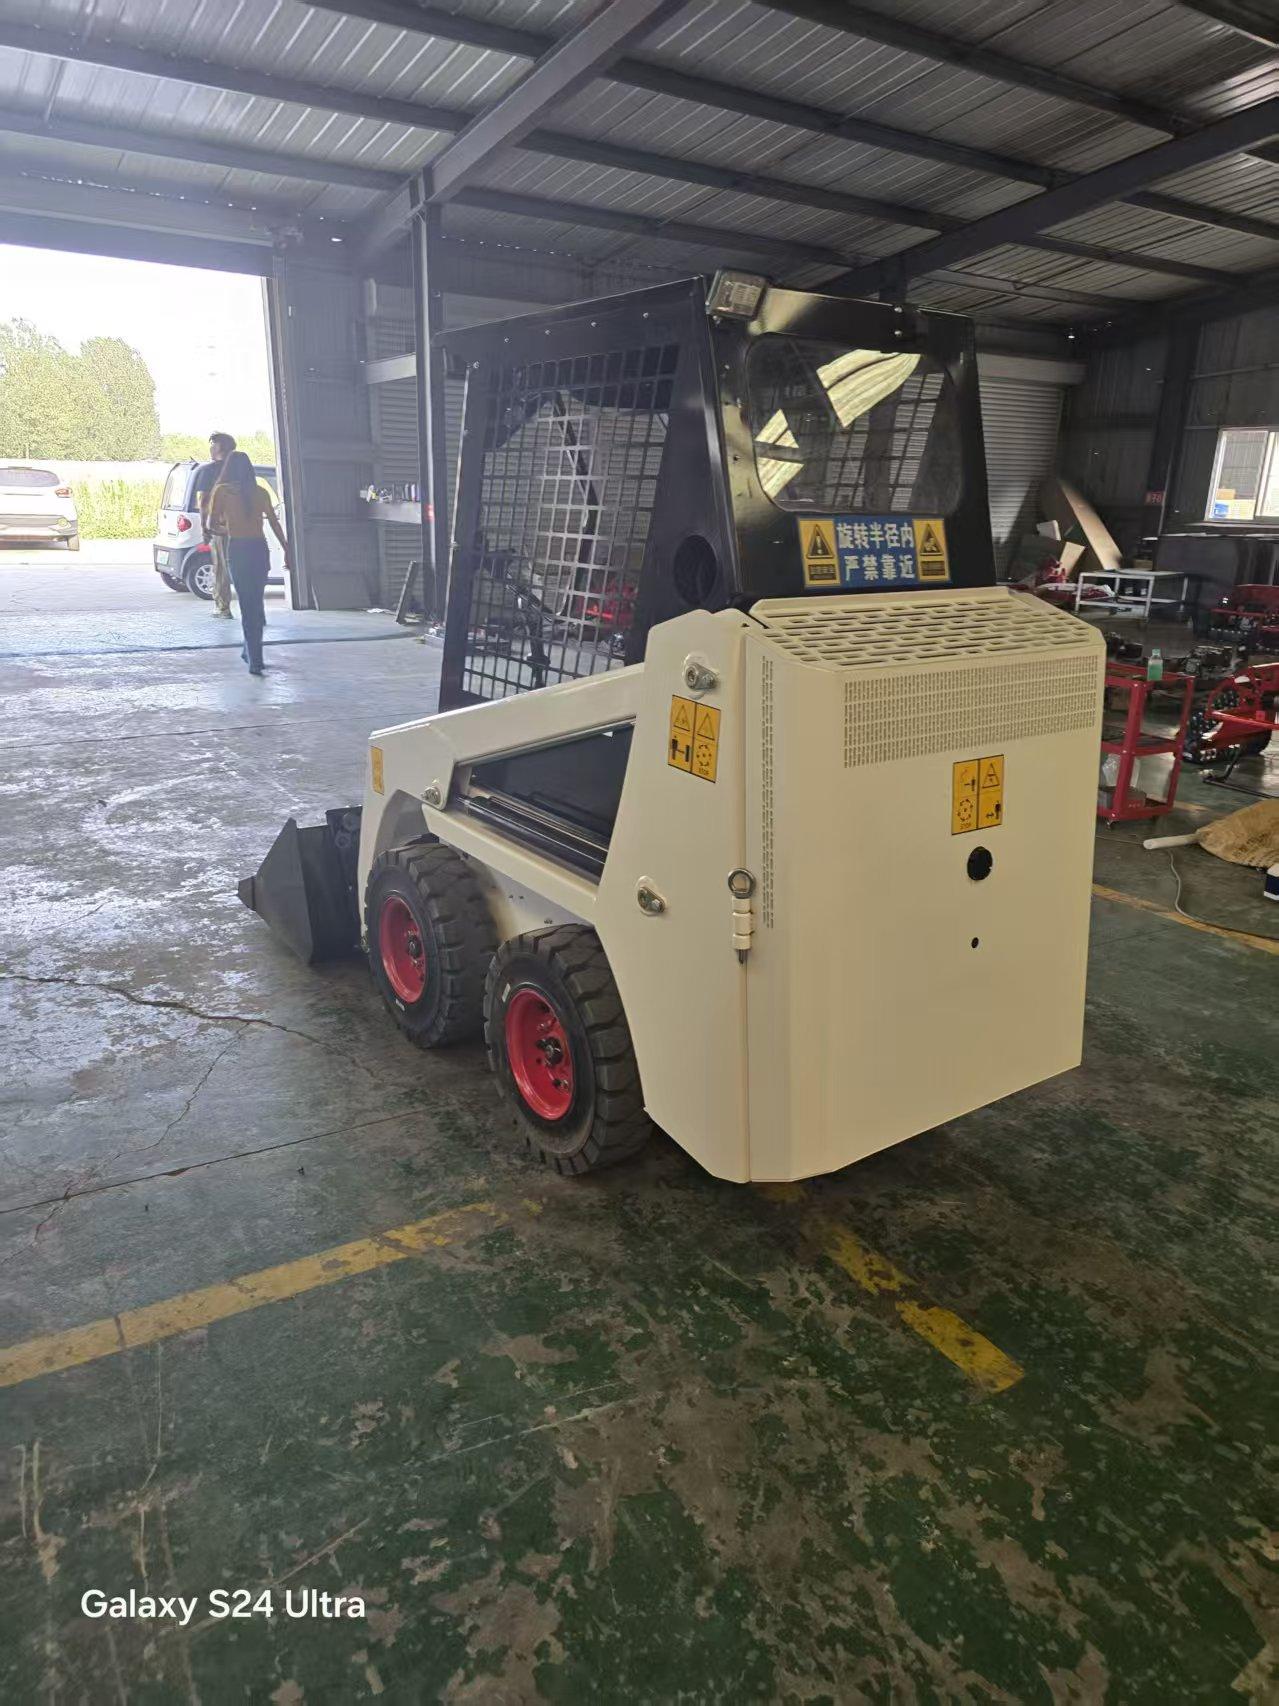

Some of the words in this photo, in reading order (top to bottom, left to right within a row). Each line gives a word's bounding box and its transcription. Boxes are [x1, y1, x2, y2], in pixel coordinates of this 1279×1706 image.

[837, 522, 915, 549] 旋转半径内
[844, 553, 916, 581] 严禁靠近
